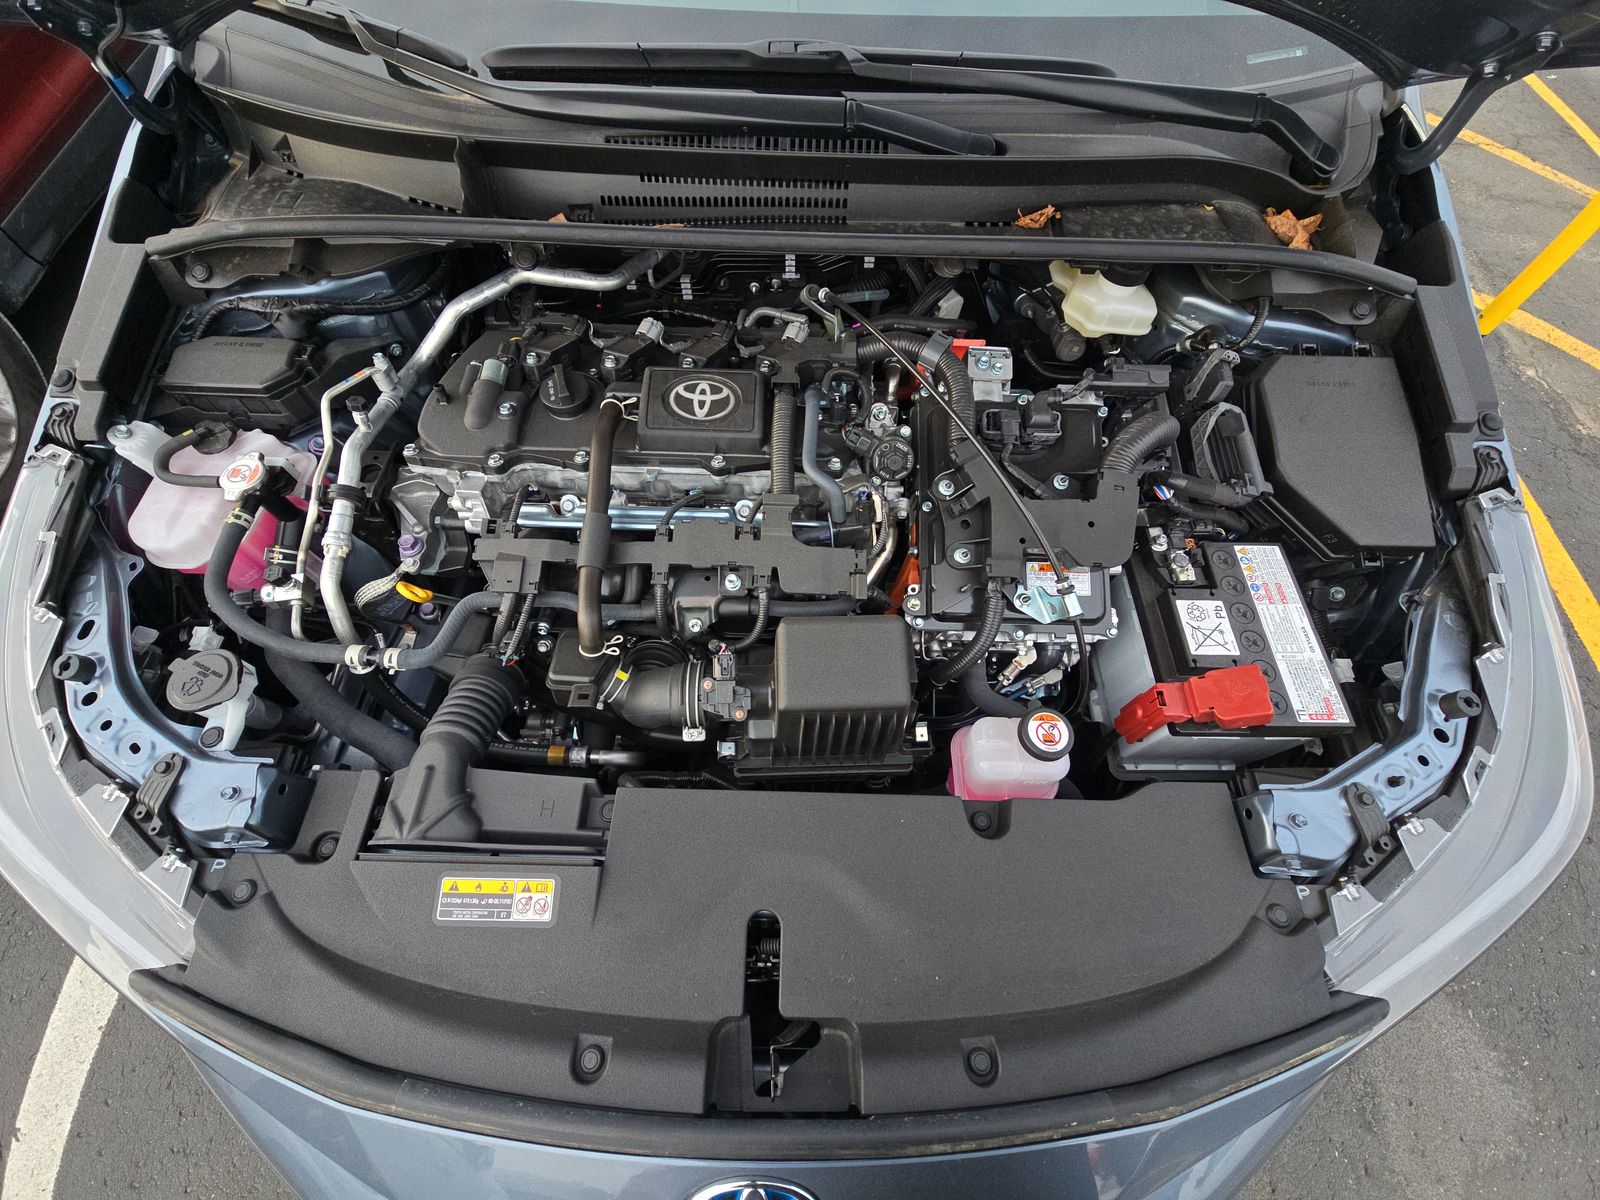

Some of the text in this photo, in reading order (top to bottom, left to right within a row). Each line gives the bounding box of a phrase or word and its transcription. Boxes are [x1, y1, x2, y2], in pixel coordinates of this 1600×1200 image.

[1213, 605, 1226, 619] Pb
[539, 799, 556, 818] H
[210, 858, 227, 873] P
